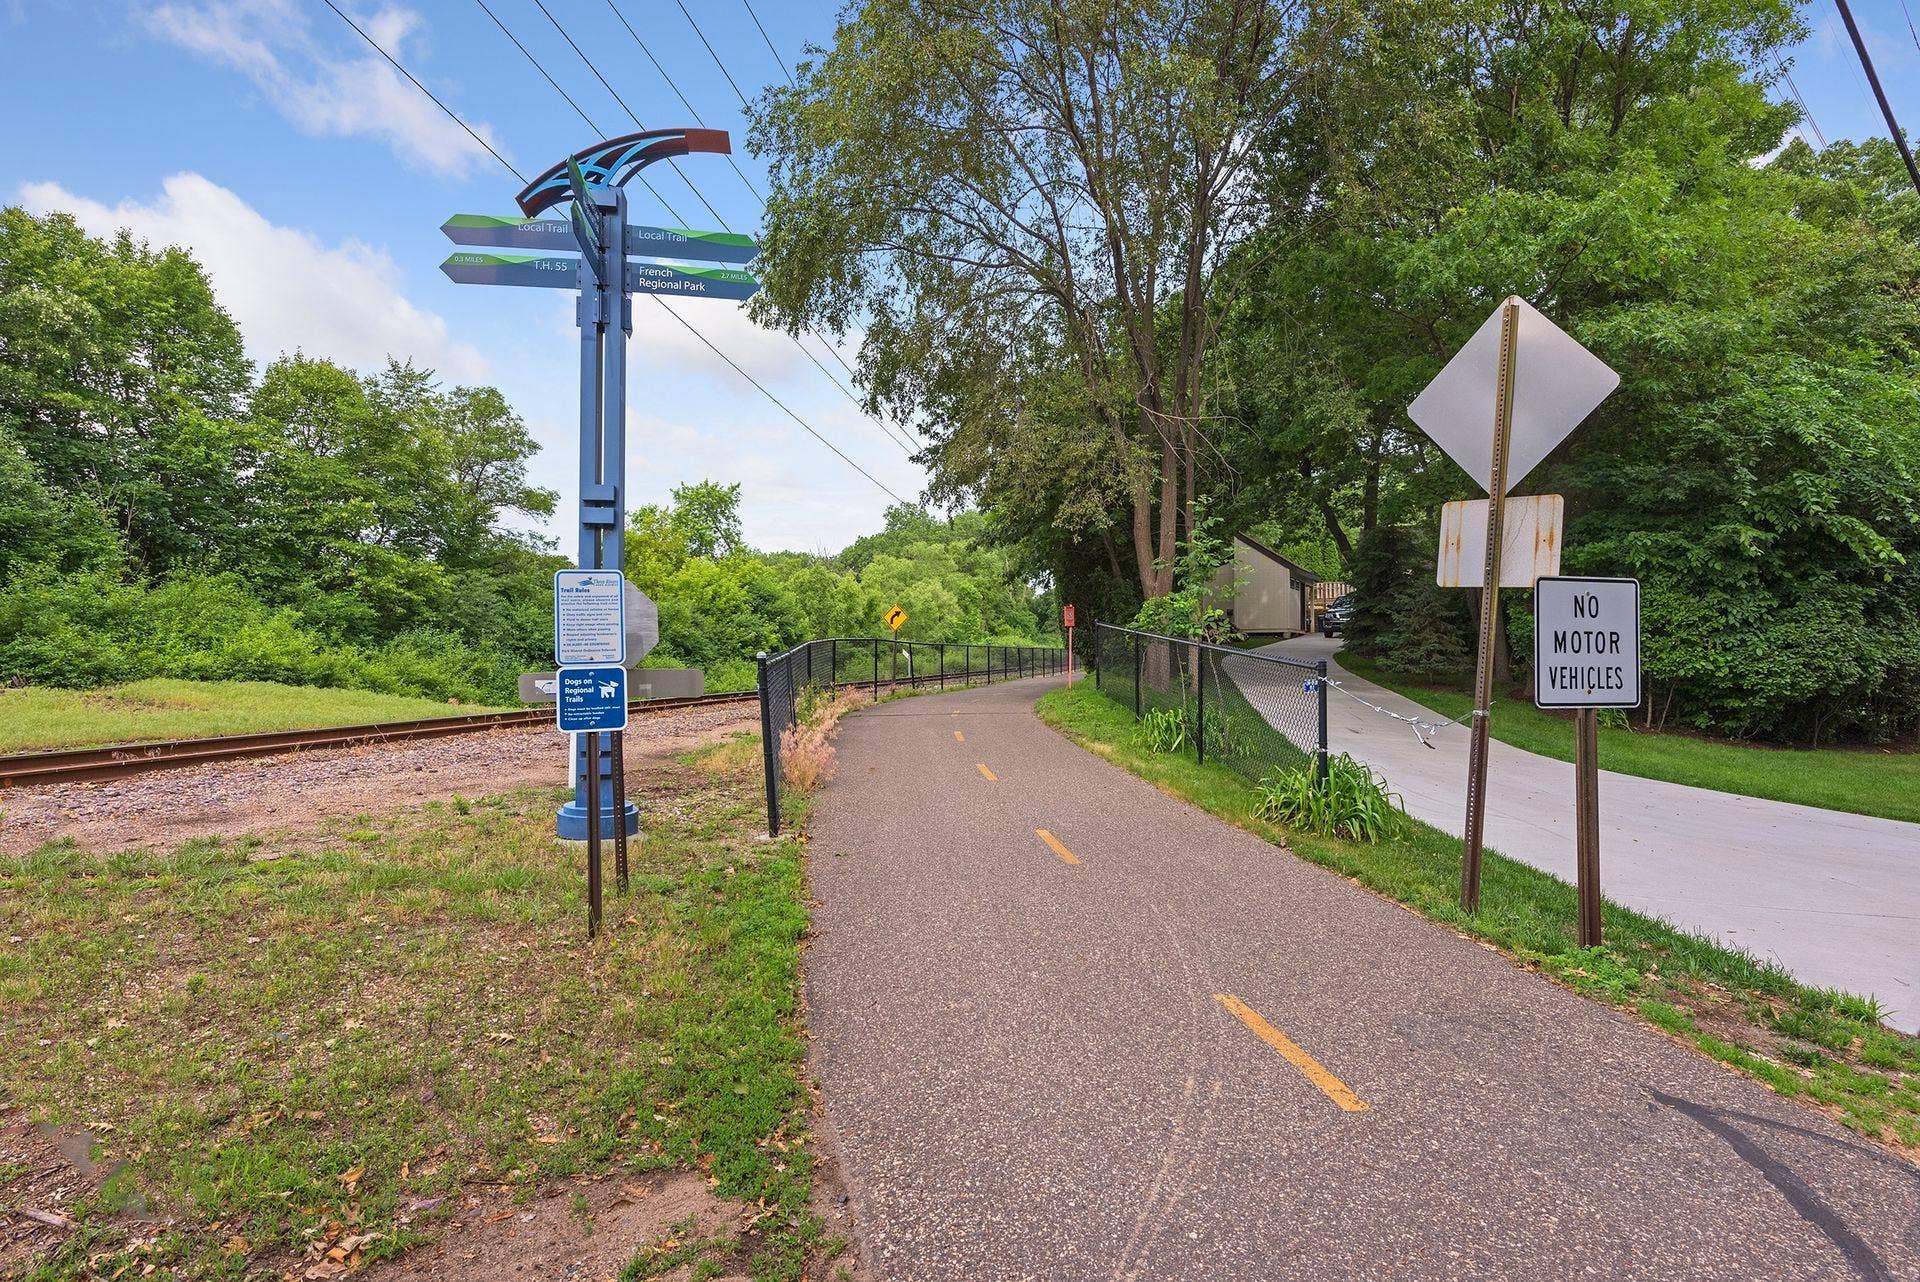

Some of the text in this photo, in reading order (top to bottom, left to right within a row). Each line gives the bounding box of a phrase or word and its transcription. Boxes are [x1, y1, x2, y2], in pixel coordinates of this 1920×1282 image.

[518, 223, 568, 234] Local Trail
[639, 230, 687, 243] Local Trail
[534, 261, 568, 271] T.H. 55
[639, 266, 673, 277] French
[639, 278, 706, 291] Regional Park
[1574, 595, 1599, 619] NO
[1554, 630, 1620, 654] MOTOR
[565, 678, 582, 686] Dogs
[1549, 666, 1623, 690] VEHICLES
[565, 686, 594, 695] Regional
